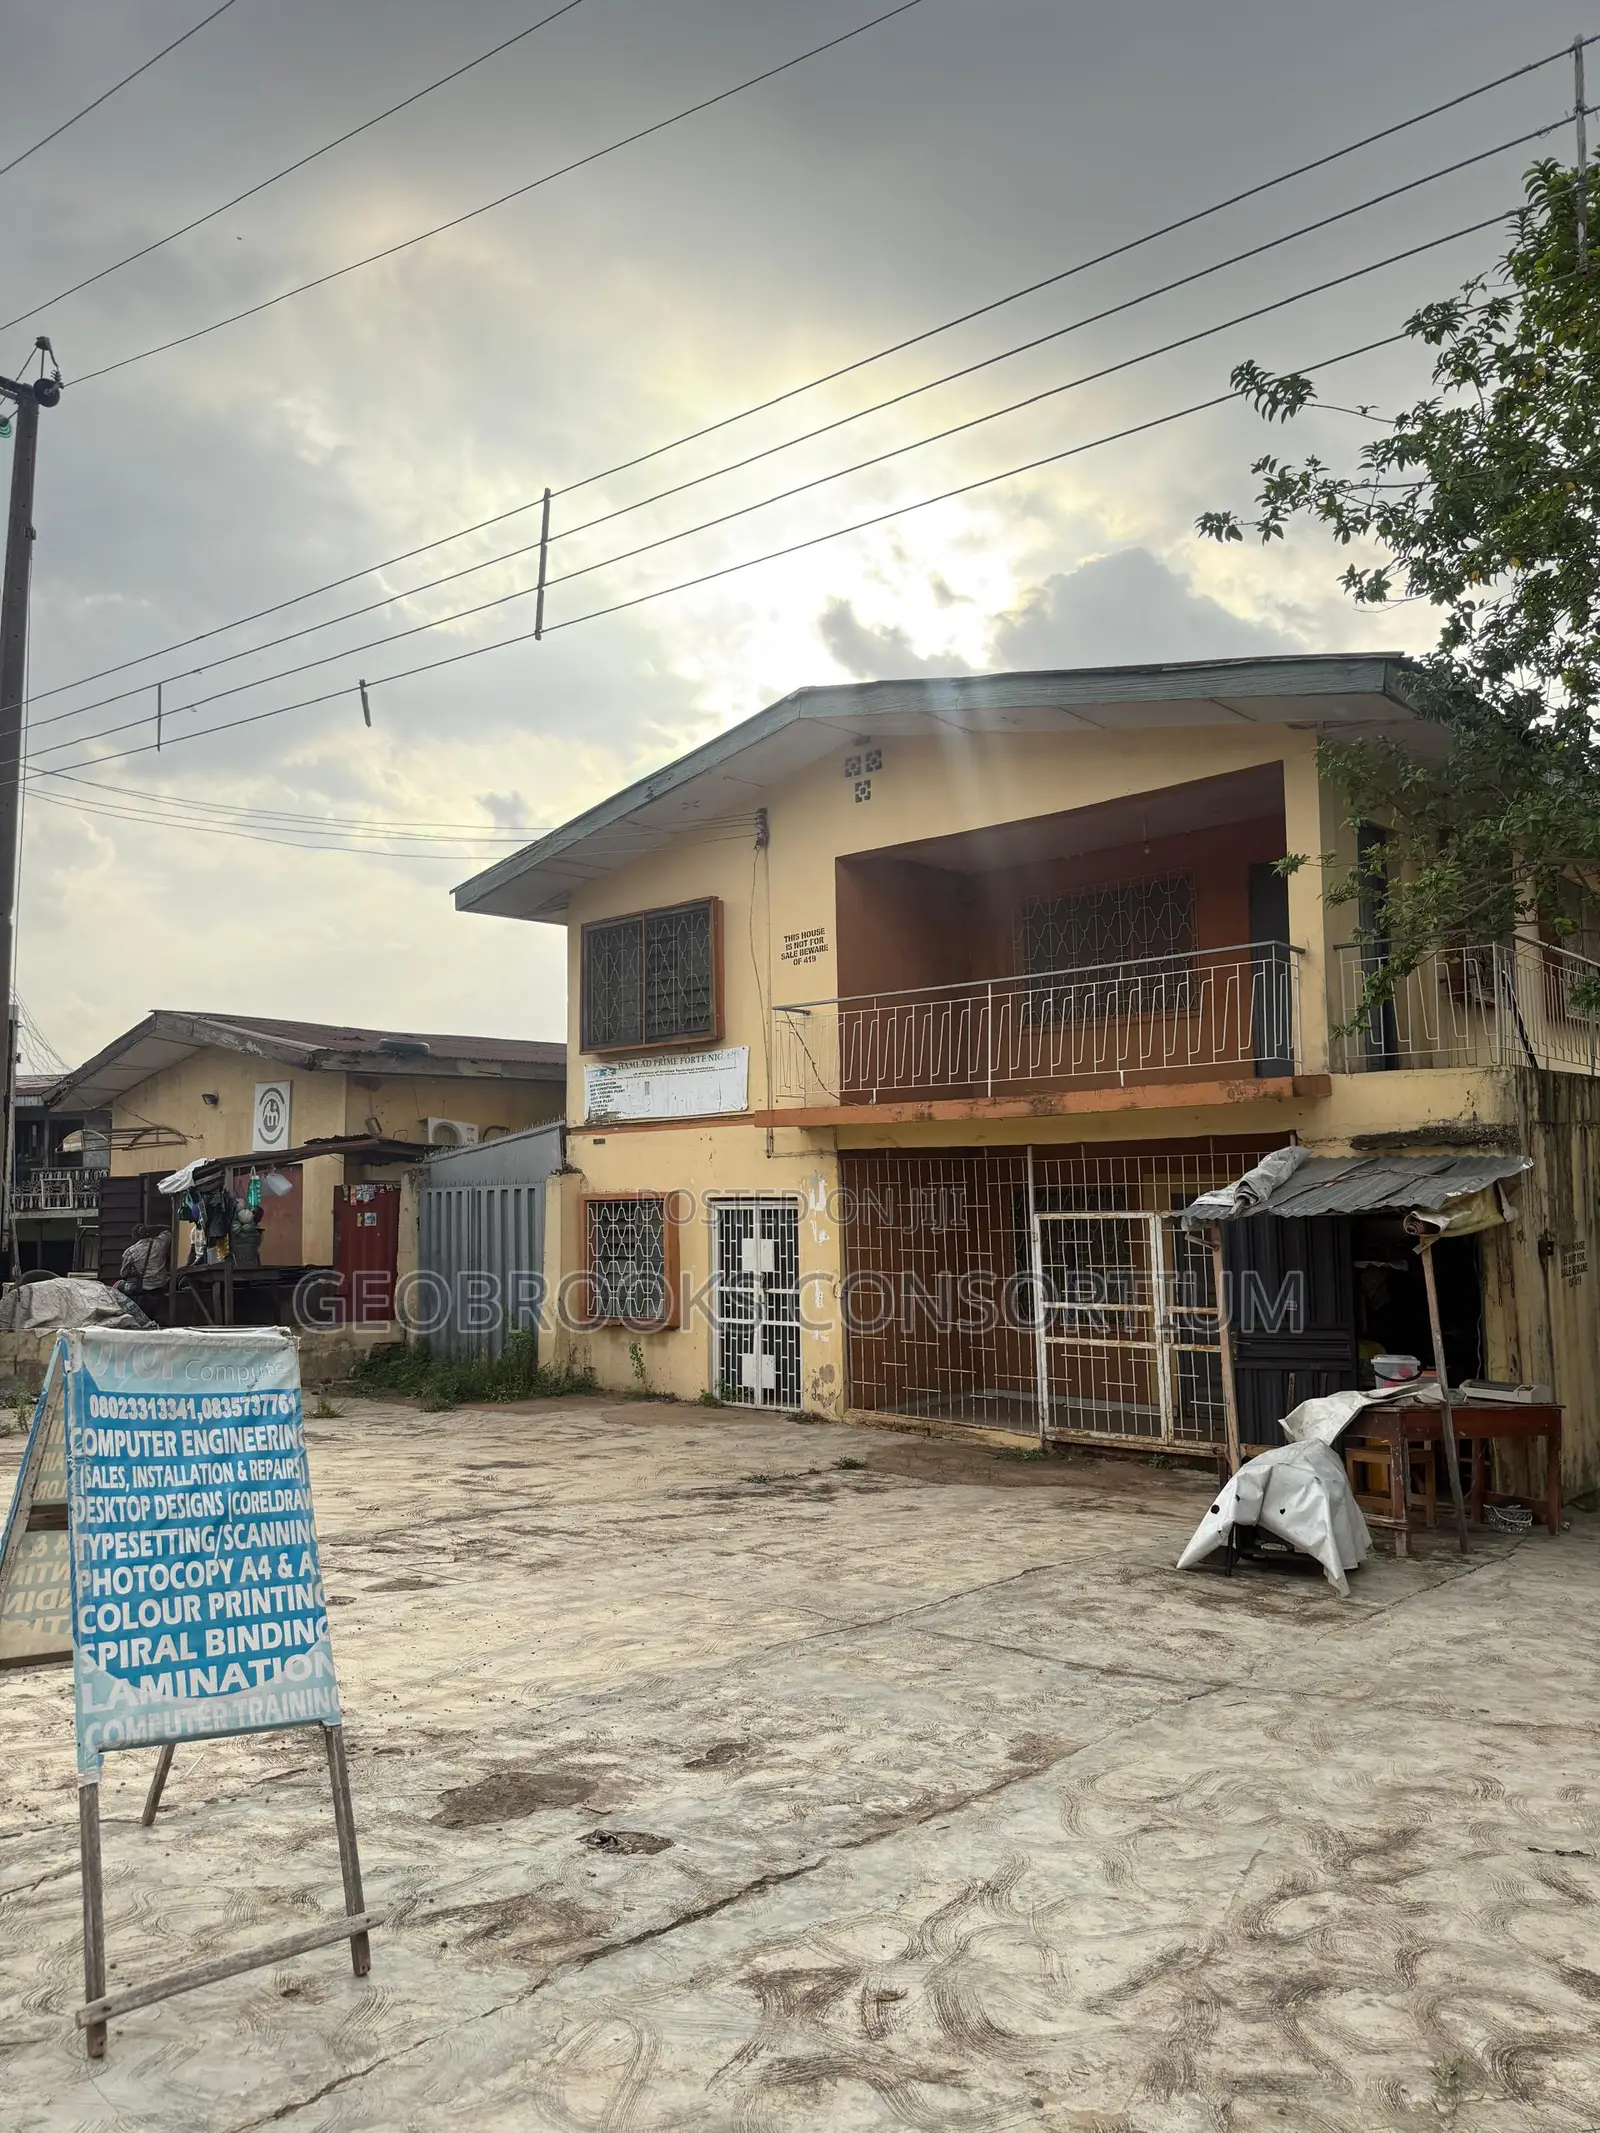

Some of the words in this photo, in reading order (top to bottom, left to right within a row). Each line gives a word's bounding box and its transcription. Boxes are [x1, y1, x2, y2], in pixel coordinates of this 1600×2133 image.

[784, 933, 800, 943] THIS
[801, 927, 826, 939] HOUSE
[786, 943, 793, 951] IS
[794, 939, 808, 949] NOT
[810, 936, 824, 946] FOR
[781, 950, 798, 960] SALE
[800, 943, 829, 956] BEWARE
[793, 957, 802, 966] OF
[804, 955, 817, 964] 419
[653, 1056, 678, 1067] PRIME
[680, 1054, 707, 1064] FORTE
[70, 1427, 177, 1458] COMPUTER
[133, 1460, 234, 1488] INSTALLATION
[237, 1460, 248, 1481] &
[73, 1494, 151, 1524] DESKTOP
[155, 1490, 225, 1521] DESIGNS
[78, 1558, 233, 1598] PHOTOCOPY
[240, 1554, 272, 1583] A4
[277, 1552, 294, 1579] &
[299, 1550, 321, 1578] A
[78, 1596, 202, 1634] COLOUR
[80, 1631, 198, 1674] SPIRAL
[81, 1651, 336, 1714] LAMINATION
[84, 1703, 229, 1753] COMPUTER
